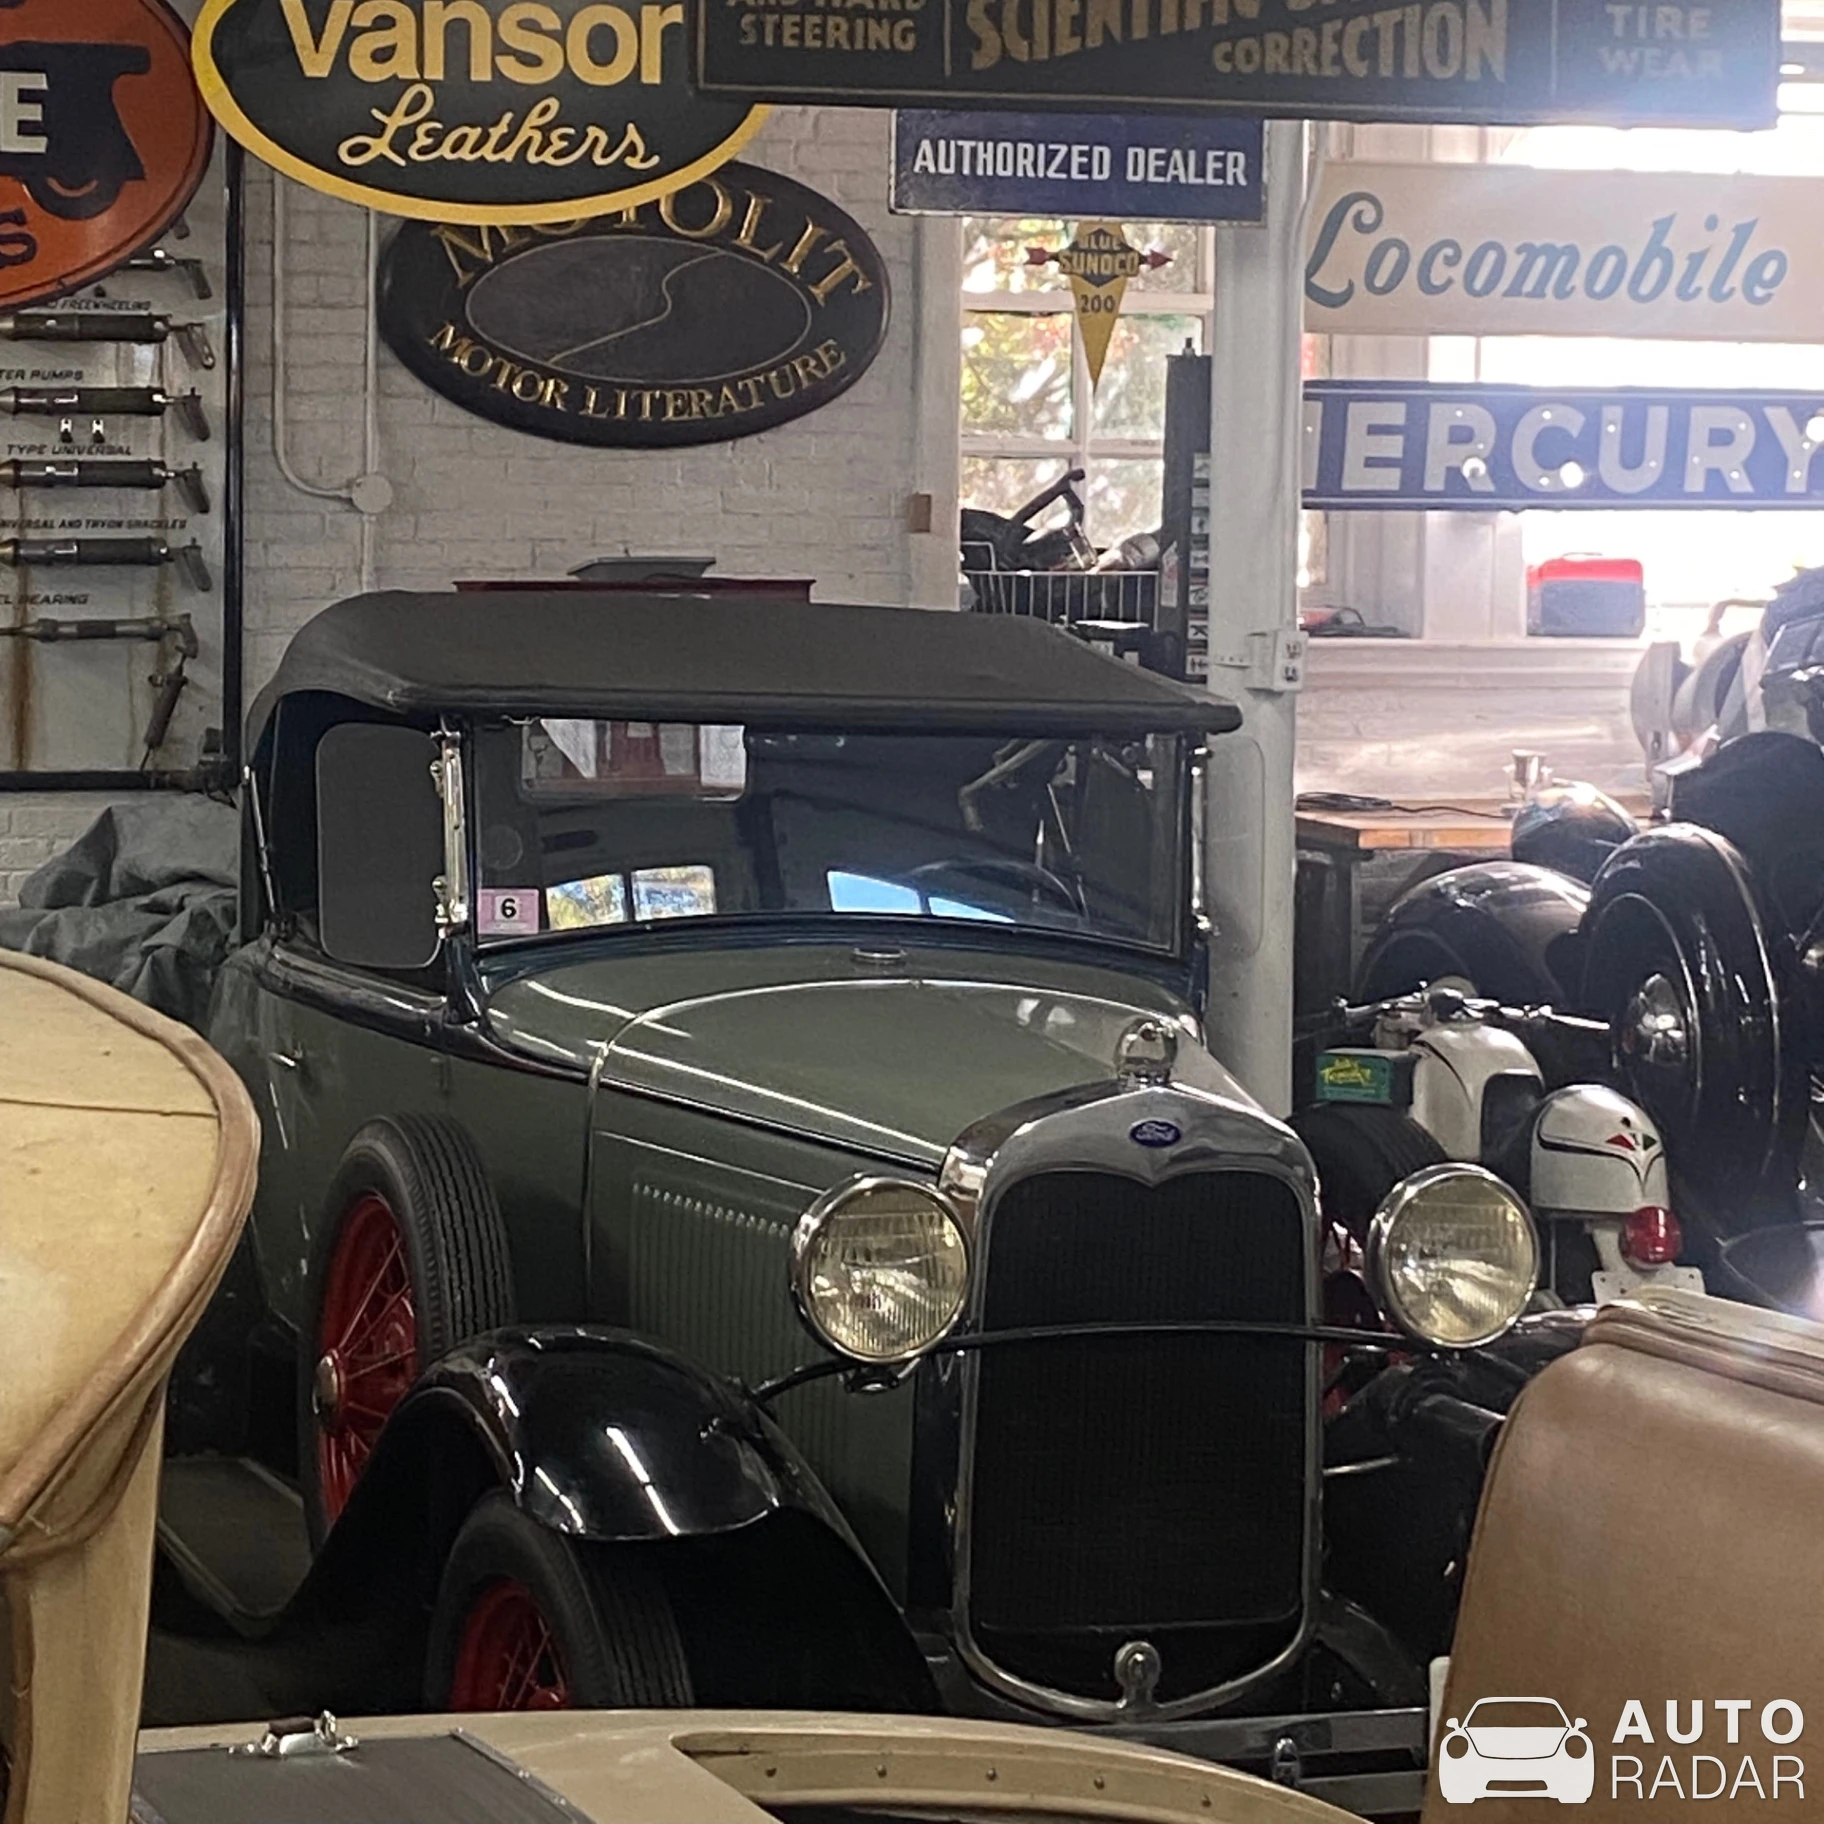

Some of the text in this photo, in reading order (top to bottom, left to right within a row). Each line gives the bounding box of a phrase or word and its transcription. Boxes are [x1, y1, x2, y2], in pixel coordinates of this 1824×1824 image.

[739, 13, 916, 51] STEERING
[1605, 4, 1712, 39] TIRE
[1212, 0, 1508, 83] CORRECTION
[1599, 47, 1724, 79] WEAR
[338, 83, 660, 170] Leathers
[913, 138, 1247, 187] AUTHORIZED DEALER
[430, 177, 872, 307] MOLIT
[1304, 191, 1789, 309] Locomobile
[1058, 251, 1140, 277] SUNOCO
[1080, 294, 1115, 314] 200
[30, 369, 84, 381] PUMPS
[425, 323, 846, 422] MOTOR LITERATURE
[7, 444, 132, 456] TYPE UNIVERSAL
[1303, 400, 1824, 494] ERCURY
[59, 519, 82, 529] AND
[501, 898, 517, 919] 6
